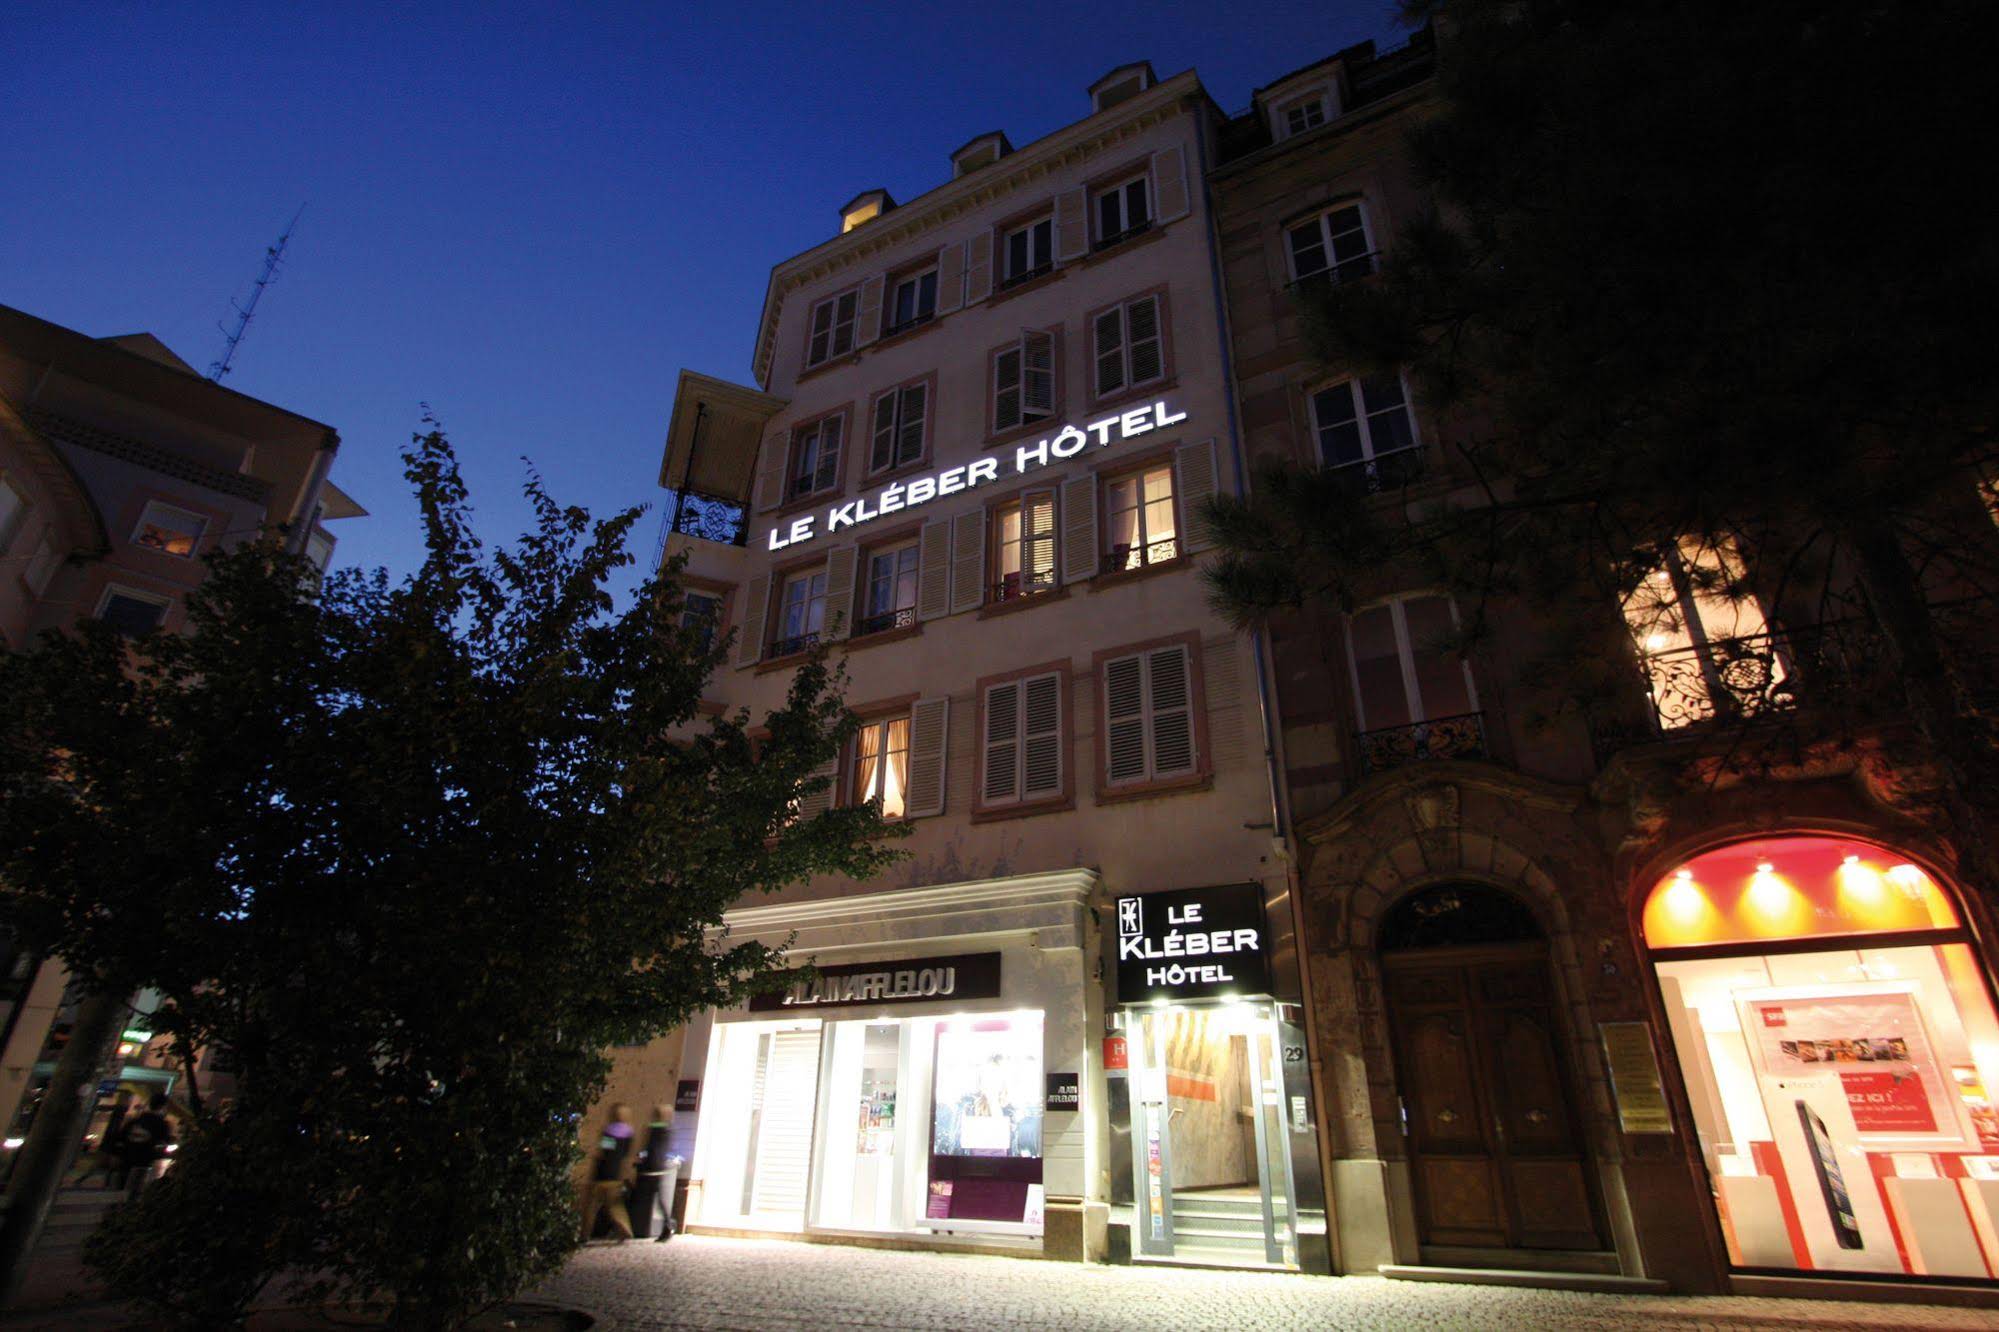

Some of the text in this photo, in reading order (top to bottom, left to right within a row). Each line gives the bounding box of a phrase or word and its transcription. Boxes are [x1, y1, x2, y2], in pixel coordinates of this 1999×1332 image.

[768, 400, 1187, 551] LE KLÉBER HÔTEL
[1168, 903, 1203, 924] LE
[1119, 928, 1259, 961] KLÉBER
[1146, 963, 1234, 986] HÔTEL
[1113, 1043, 1126, 1055] H
